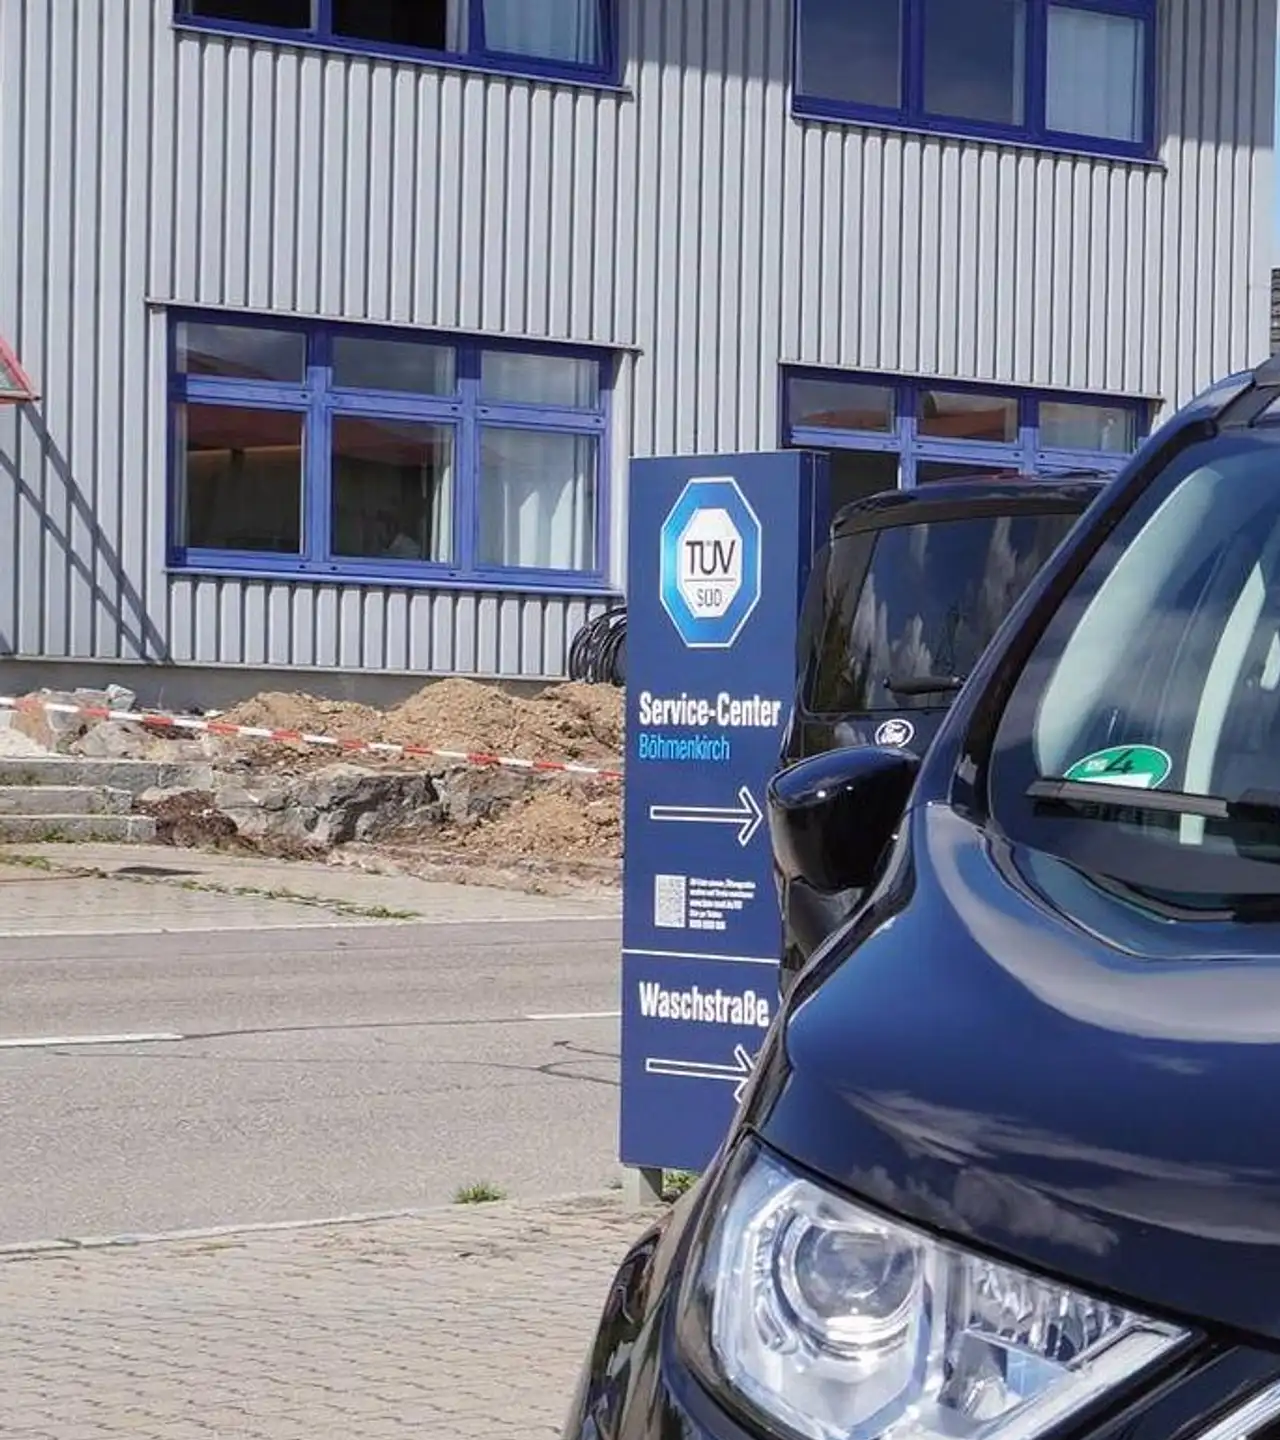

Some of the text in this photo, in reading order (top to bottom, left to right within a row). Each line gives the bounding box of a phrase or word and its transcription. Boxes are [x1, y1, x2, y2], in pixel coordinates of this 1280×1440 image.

[685, 540, 736, 575] TÜV
[638, 690, 782, 728] Service-Center
[638, 733, 730, 761] Böhmenkirch
[1103, 748, 1134, 773] 4
[638, 981, 769, 1027] Waschstraße
